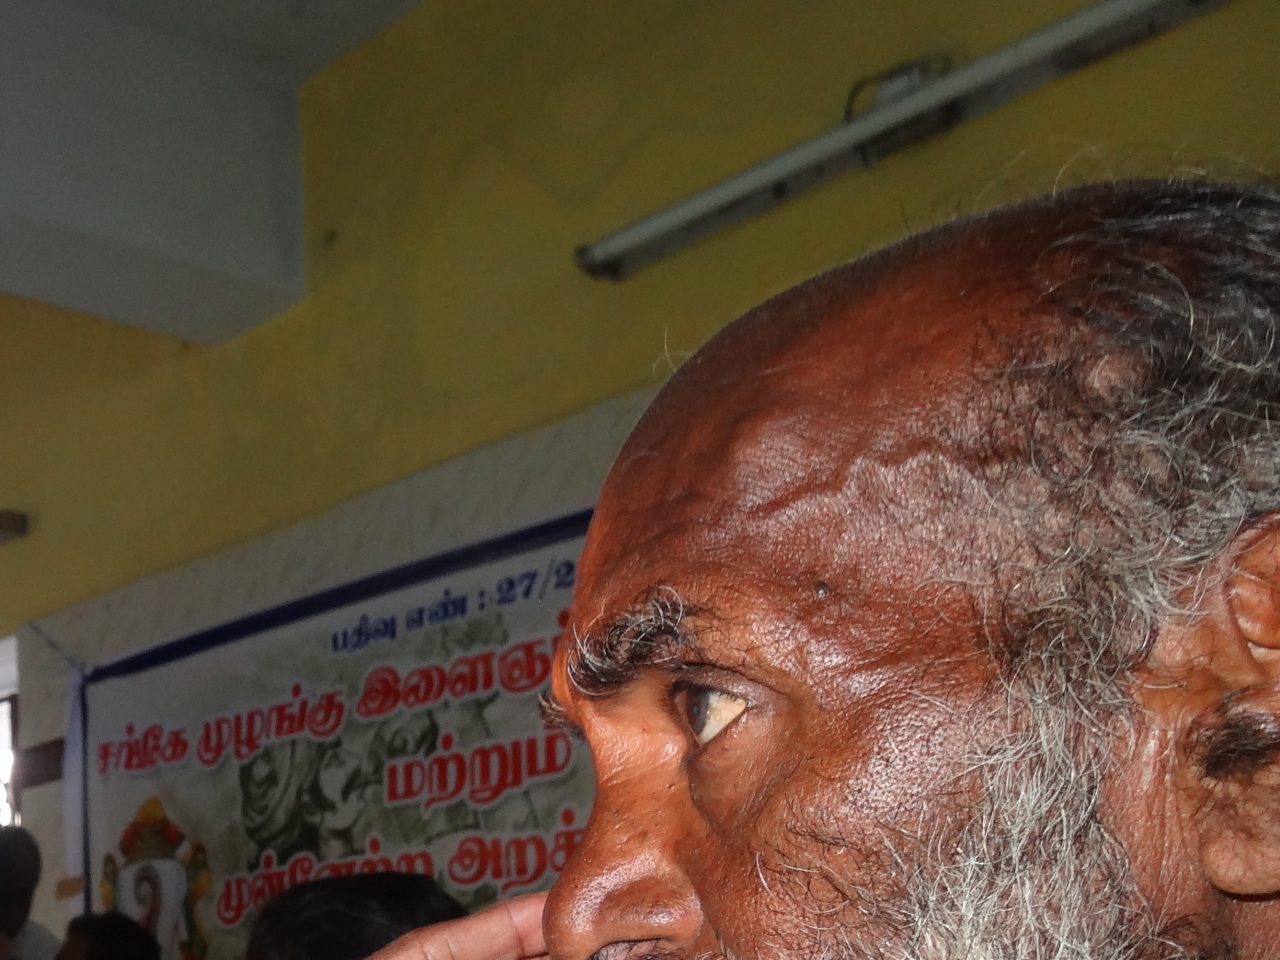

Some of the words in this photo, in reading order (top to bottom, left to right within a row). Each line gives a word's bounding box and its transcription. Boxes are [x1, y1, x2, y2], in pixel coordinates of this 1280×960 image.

[331, 614, 397, 654] பதிவு
[405, 588, 467, 631] எண்
[196, 682, 346, 766] முழங்கு
